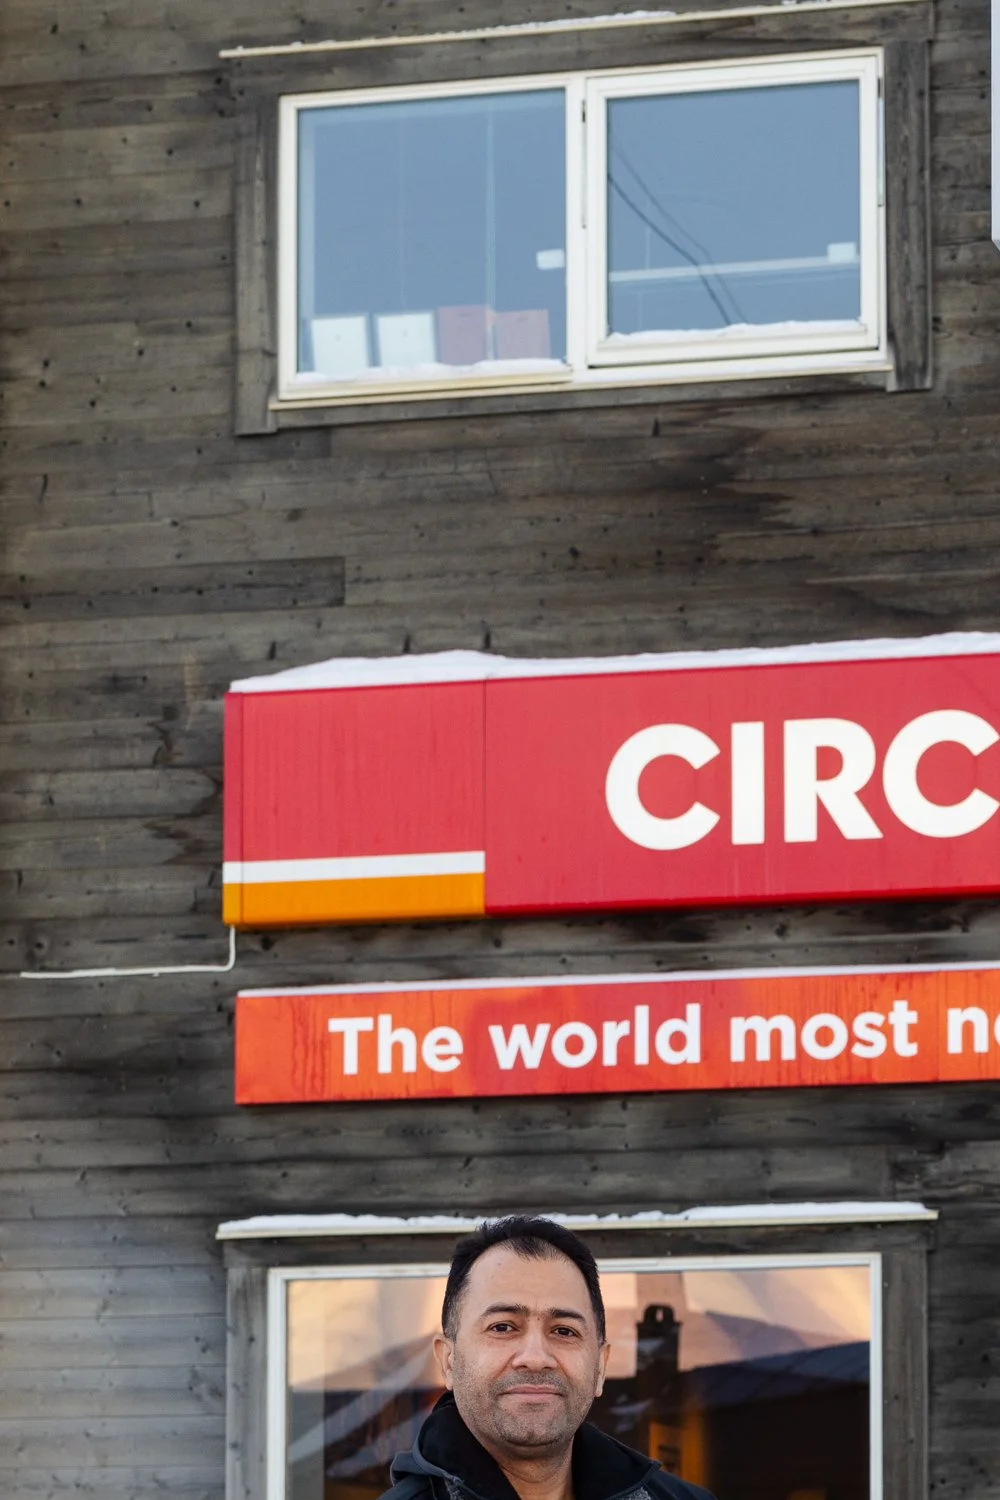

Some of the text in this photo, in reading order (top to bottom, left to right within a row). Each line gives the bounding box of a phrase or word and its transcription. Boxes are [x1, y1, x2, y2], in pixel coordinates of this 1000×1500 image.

[327, 1014, 464, 1075] The
[488, 1003, 701, 1070] world
[729, 999, 919, 1063] most
